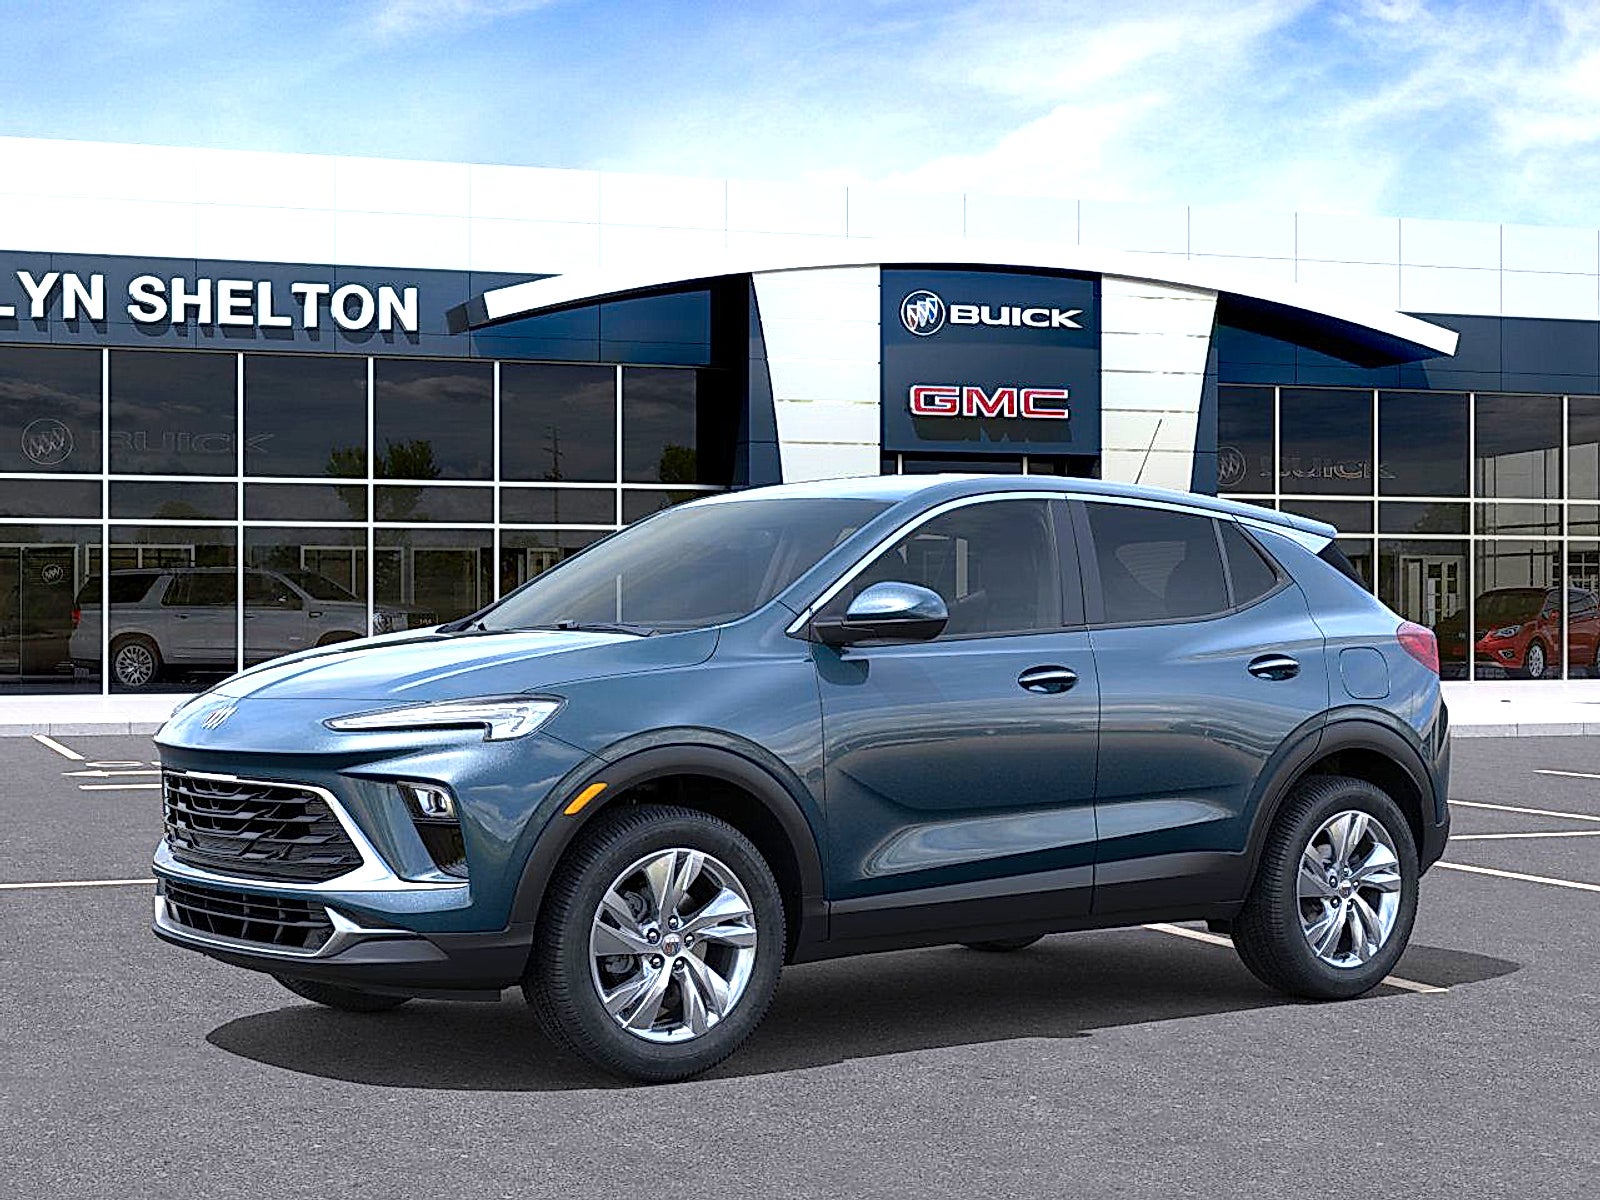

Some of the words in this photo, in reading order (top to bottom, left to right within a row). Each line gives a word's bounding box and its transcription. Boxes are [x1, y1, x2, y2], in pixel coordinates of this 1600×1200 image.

[127, 274, 419, 332] SHELTON
[950, 304, 1084, 329] BUICK
[909, 385, 1069, 419] GMC
